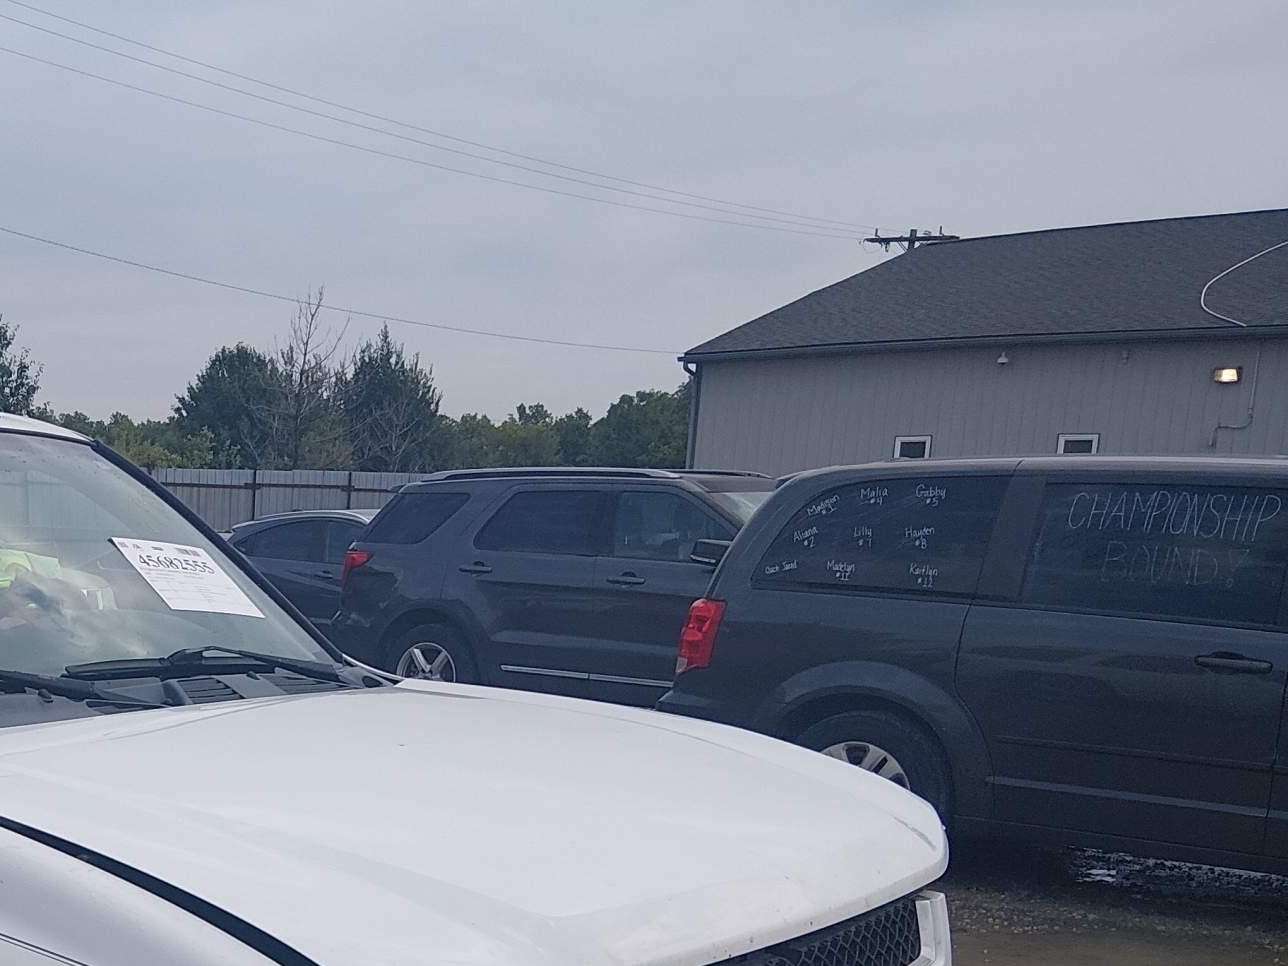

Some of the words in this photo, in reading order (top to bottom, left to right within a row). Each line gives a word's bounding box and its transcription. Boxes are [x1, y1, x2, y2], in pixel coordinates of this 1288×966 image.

[860, 487, 889, 499] Malia
[915, 484, 947, 499] Gabby
[1068, 490, 1282, 542] CHAMPIONSHIP
[854, 527, 873, 539] Lilly
[904, 526, 936, 540] Hayden
[138, 553, 216, 575] 45682555
